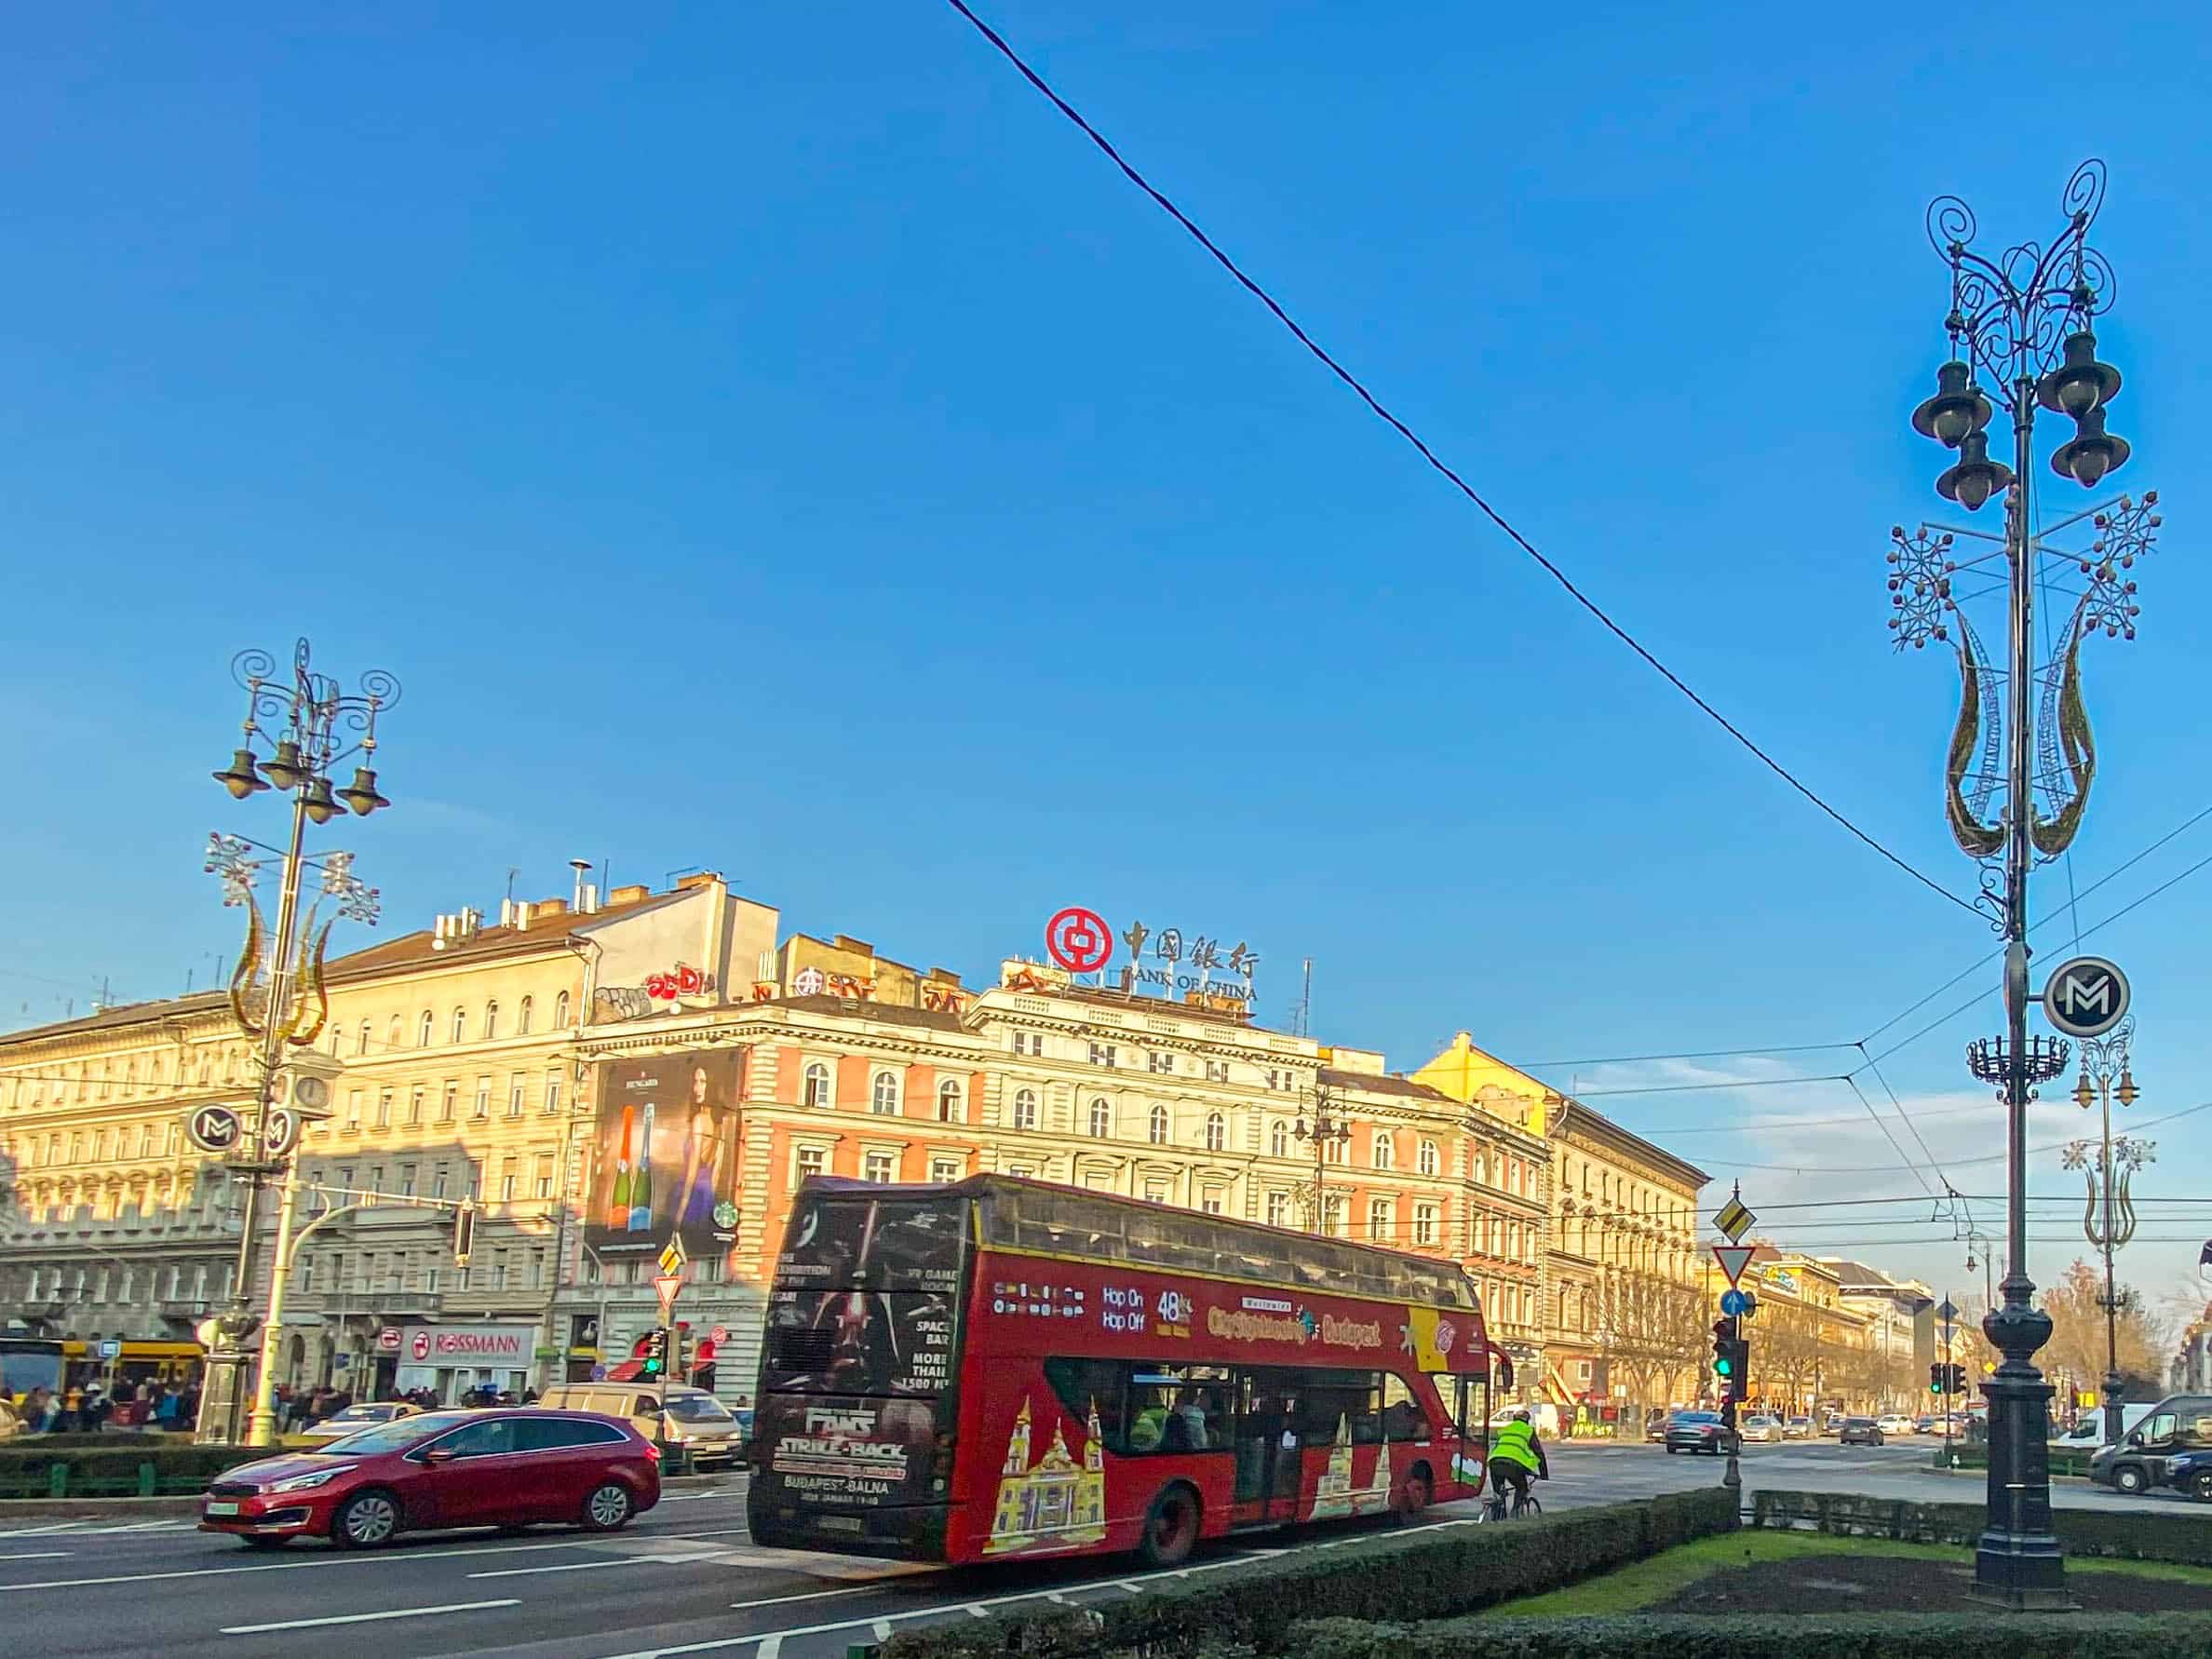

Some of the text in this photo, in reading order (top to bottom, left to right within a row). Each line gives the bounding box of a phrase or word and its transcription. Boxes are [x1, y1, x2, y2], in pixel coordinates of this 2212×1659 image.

[1127, 965, 1258, 1001] ANK OF CHINA
[2065, 974, 2110, 1015] M
[202, 1113, 233, 1141] M
[925, 1270, 957, 1281] GAME
[1103, 1287, 1143, 1309] Hop On
[1157, 1290, 1179, 1321] 48
[916, 1321, 950, 1332] SPACE
[1103, 1311, 1145, 1332] Hop Off
[1322, 1314, 1382, 1350] Budapest
[437, 1332, 521, 1354] ROSSMANN
[926, 1334, 949, 1344] BAR
[912, 1353, 947, 1365] MORE
